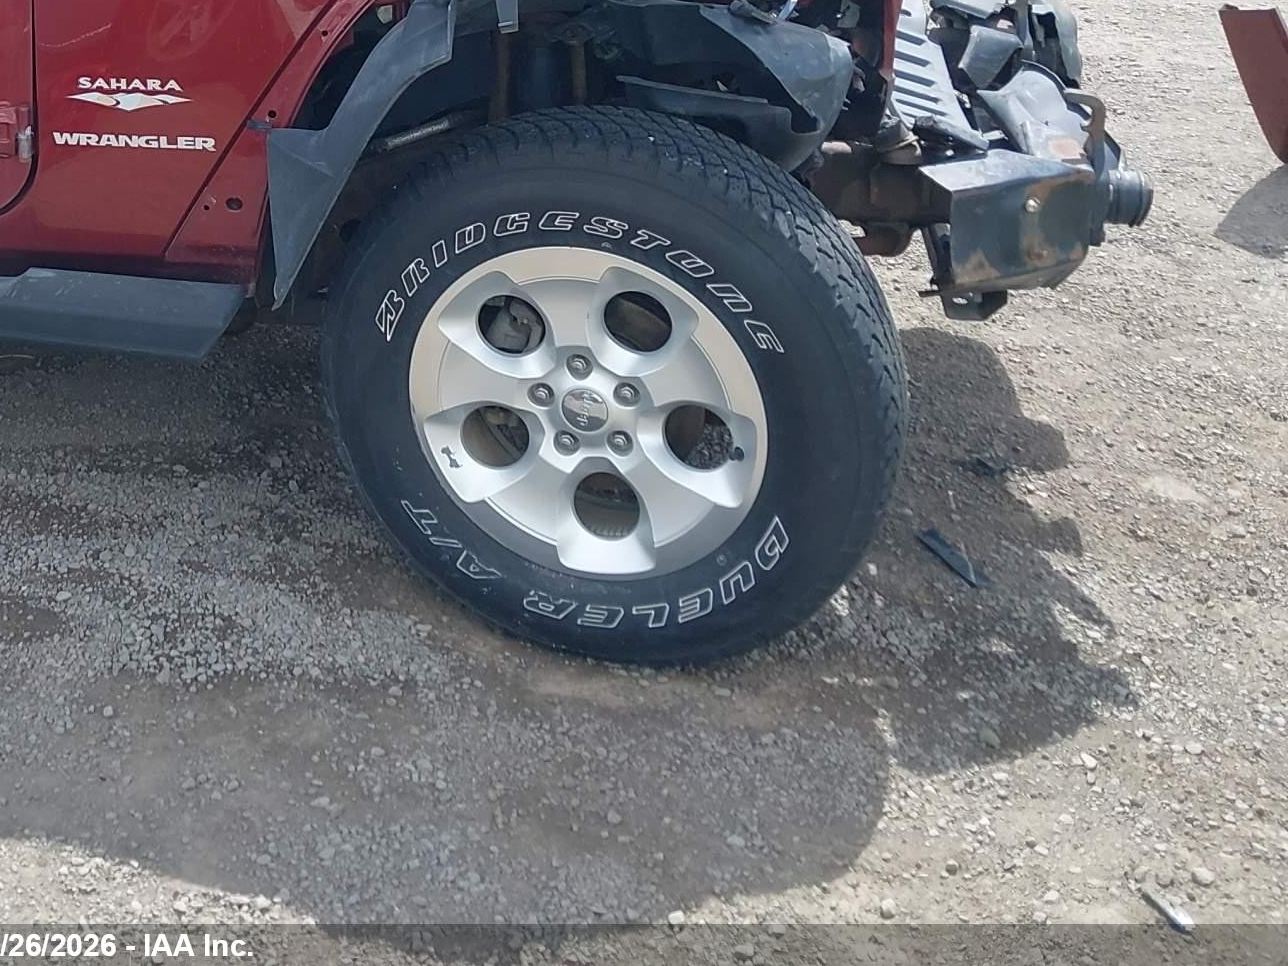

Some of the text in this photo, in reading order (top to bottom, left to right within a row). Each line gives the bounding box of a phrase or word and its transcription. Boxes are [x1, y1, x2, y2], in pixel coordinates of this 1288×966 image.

[78, 77, 182, 91] SAHARA
[53, 132, 216, 151] WRANGLER
[376, 211, 785, 354] BRIDGESTONE
[400, 499, 790, 629] DUELER A/T
